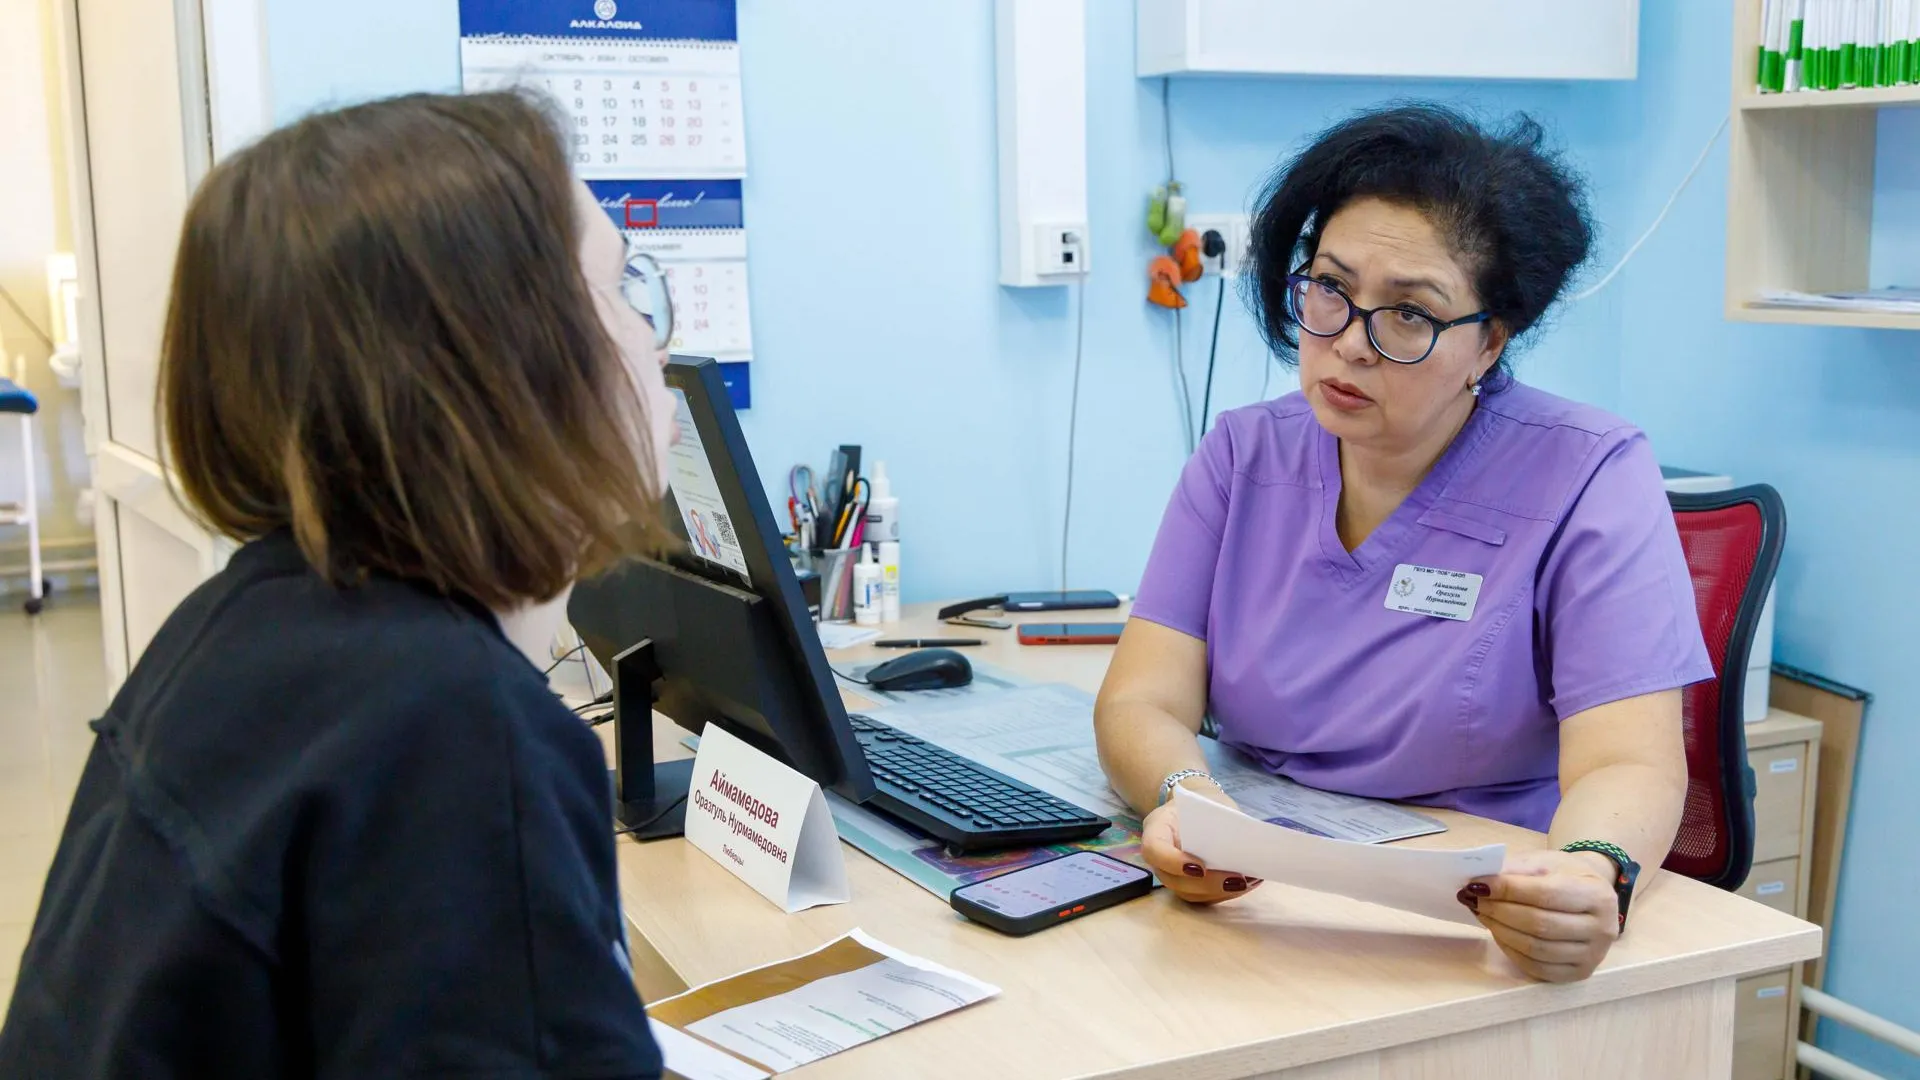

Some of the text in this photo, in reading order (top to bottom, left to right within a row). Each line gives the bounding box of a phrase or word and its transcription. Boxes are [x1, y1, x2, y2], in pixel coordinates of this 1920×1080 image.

[569, 19, 643, 30] АЛКАЛОИД
[573, 79, 583, 91] 2
[603, 80, 613, 91] 3
[632, 80, 641, 91] 4
[660, 81, 670, 92] 5
[688, 81, 698, 92] 6
[574, 97, 702, 111] 9 10 11 12 13
[602, 115, 618, 127] 17
[631, 116, 647, 128] 18
[660, 116, 675, 128] 19
[686, 116, 703, 128] 20
[601, 134, 619, 146] 24
[631, 134, 648, 146] 25
[659, 134, 676, 147] 26
[687, 134, 703, 147] 27
[603, 152, 618, 164] 31
[634, 243, 683, 251] NOVEMBER
[694, 266, 703, 278] 3
[693, 284, 708, 295] 10
[693, 301, 708, 313] 17
[693, 319, 709, 331] 24
[709, 768, 780, 829] Аймамедова
[694, 788, 788, 864] Оразгуль Нурмамедовна
